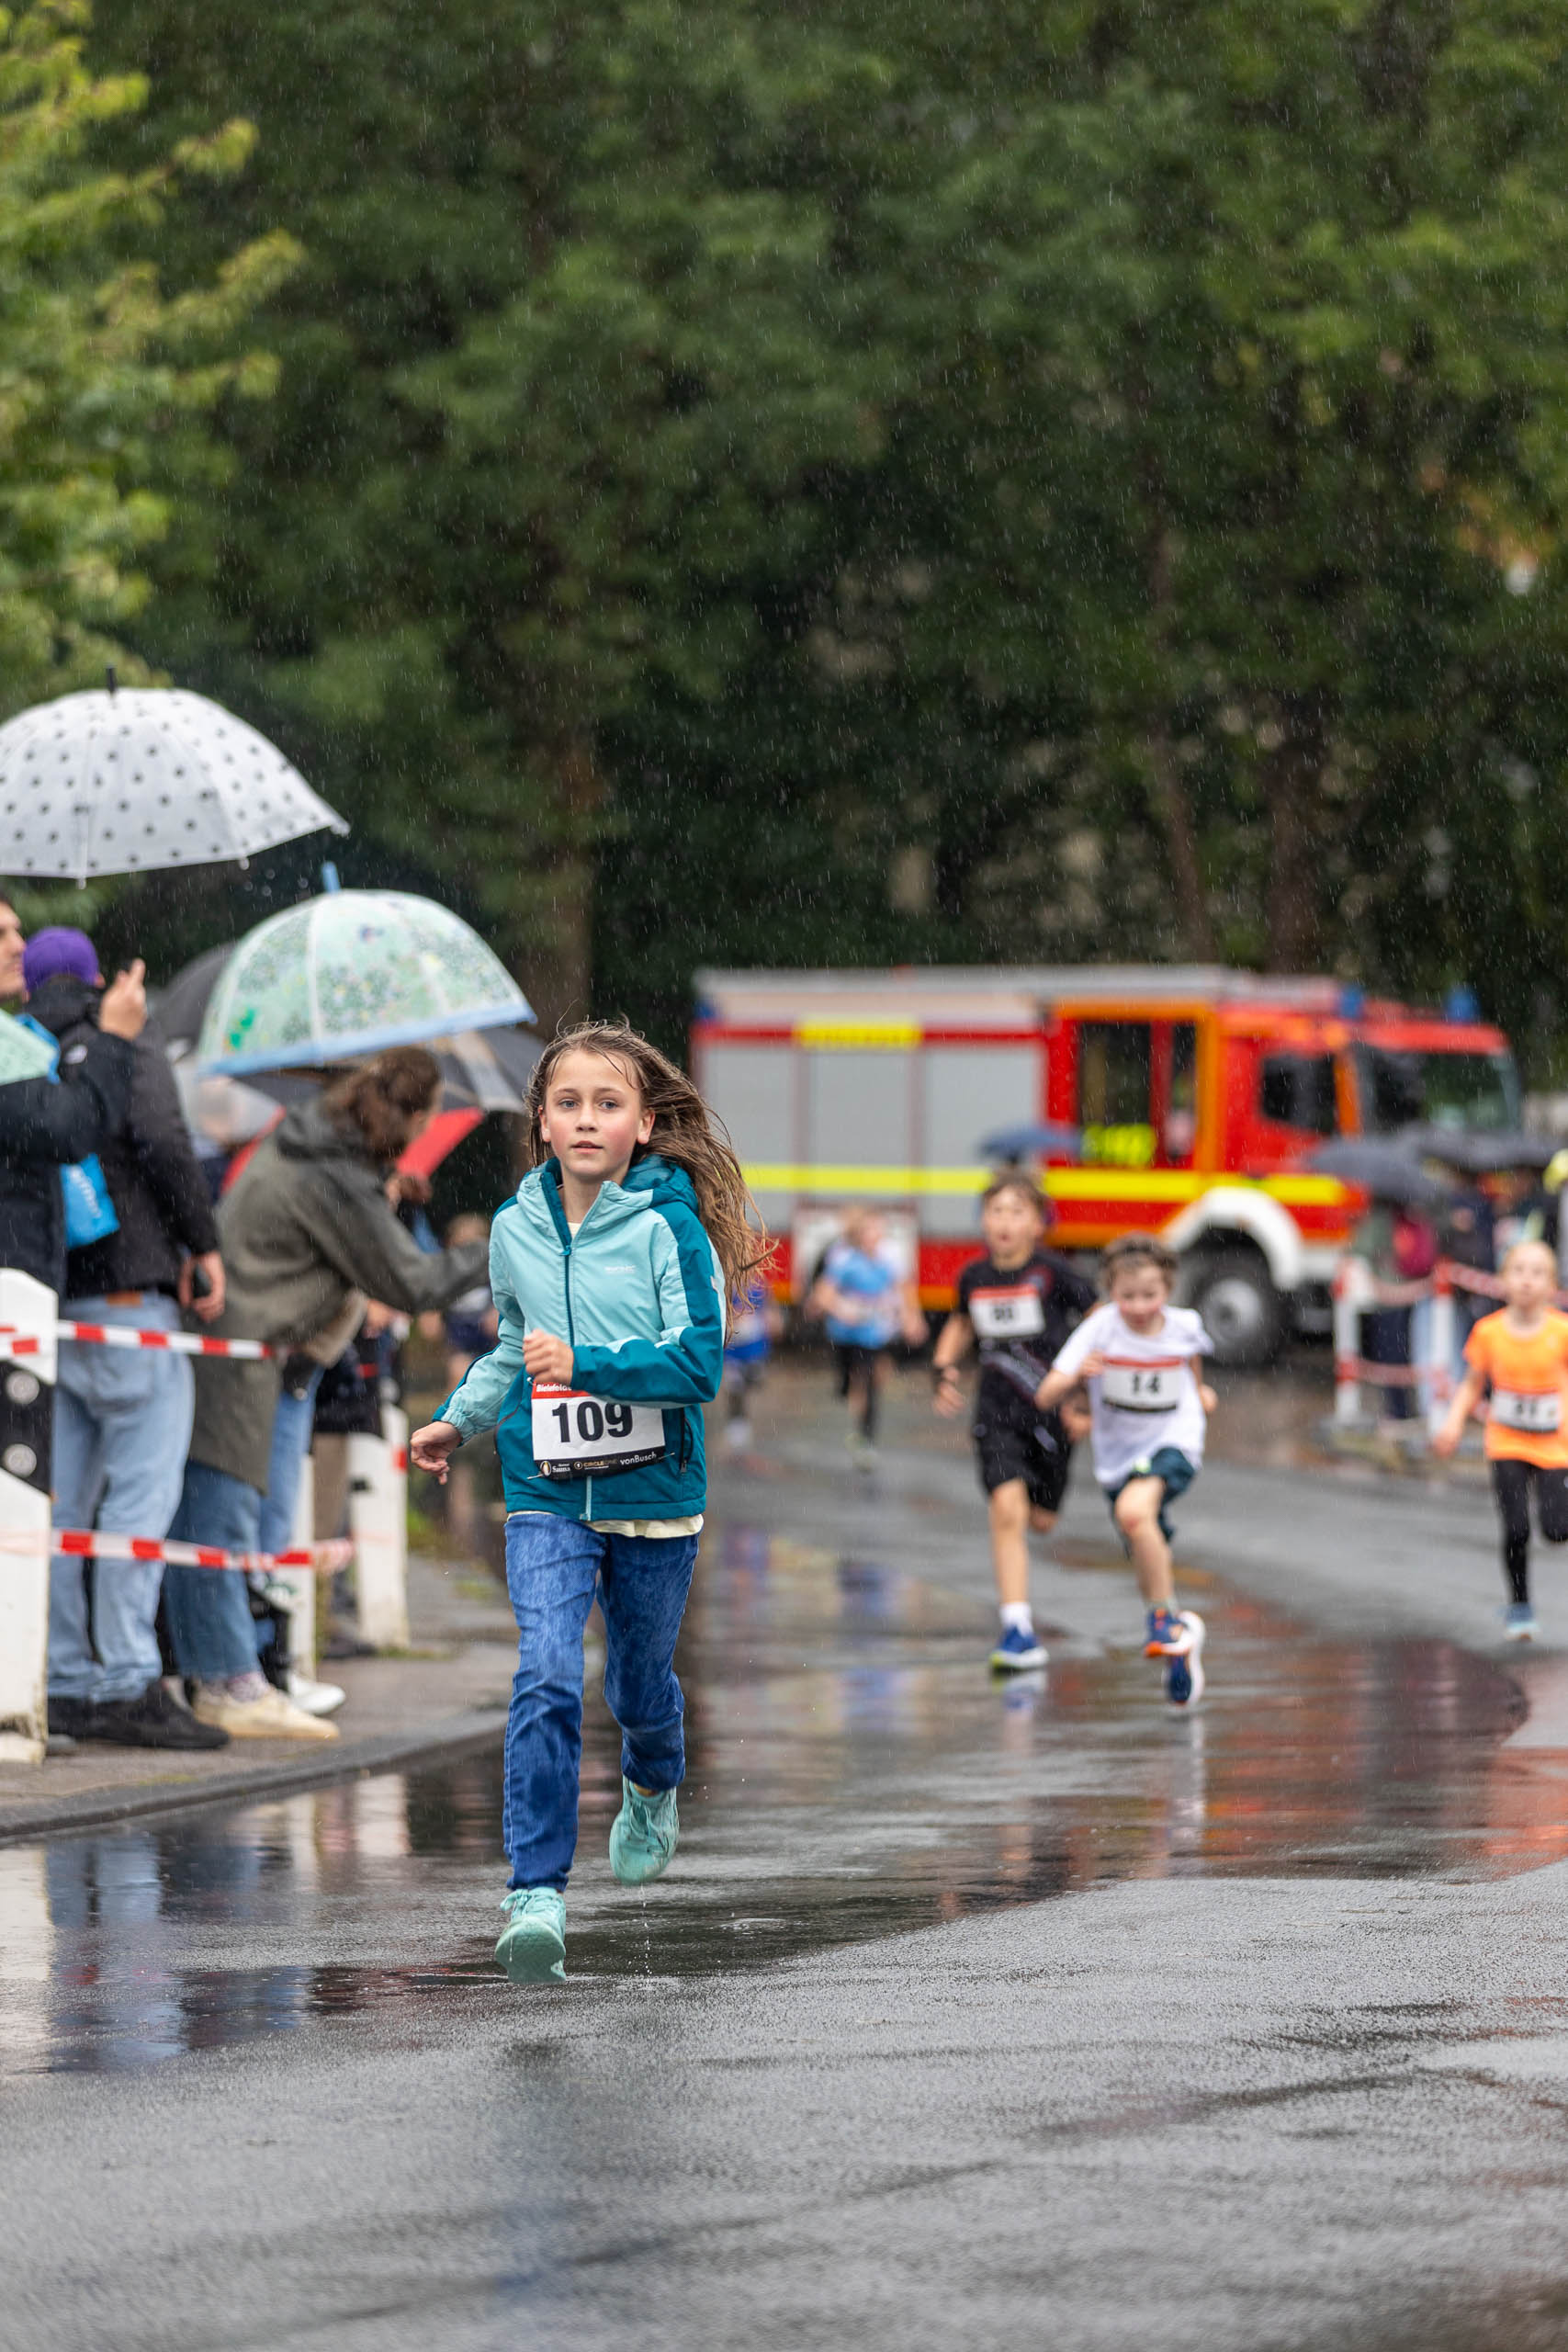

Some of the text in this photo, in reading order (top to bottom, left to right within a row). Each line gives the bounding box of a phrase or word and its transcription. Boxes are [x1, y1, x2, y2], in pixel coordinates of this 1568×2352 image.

[1131, 1372, 1161, 1394] 14
[552, 1401, 633, 1442] 109
[620, 1452, 657, 1465] vonBusch
